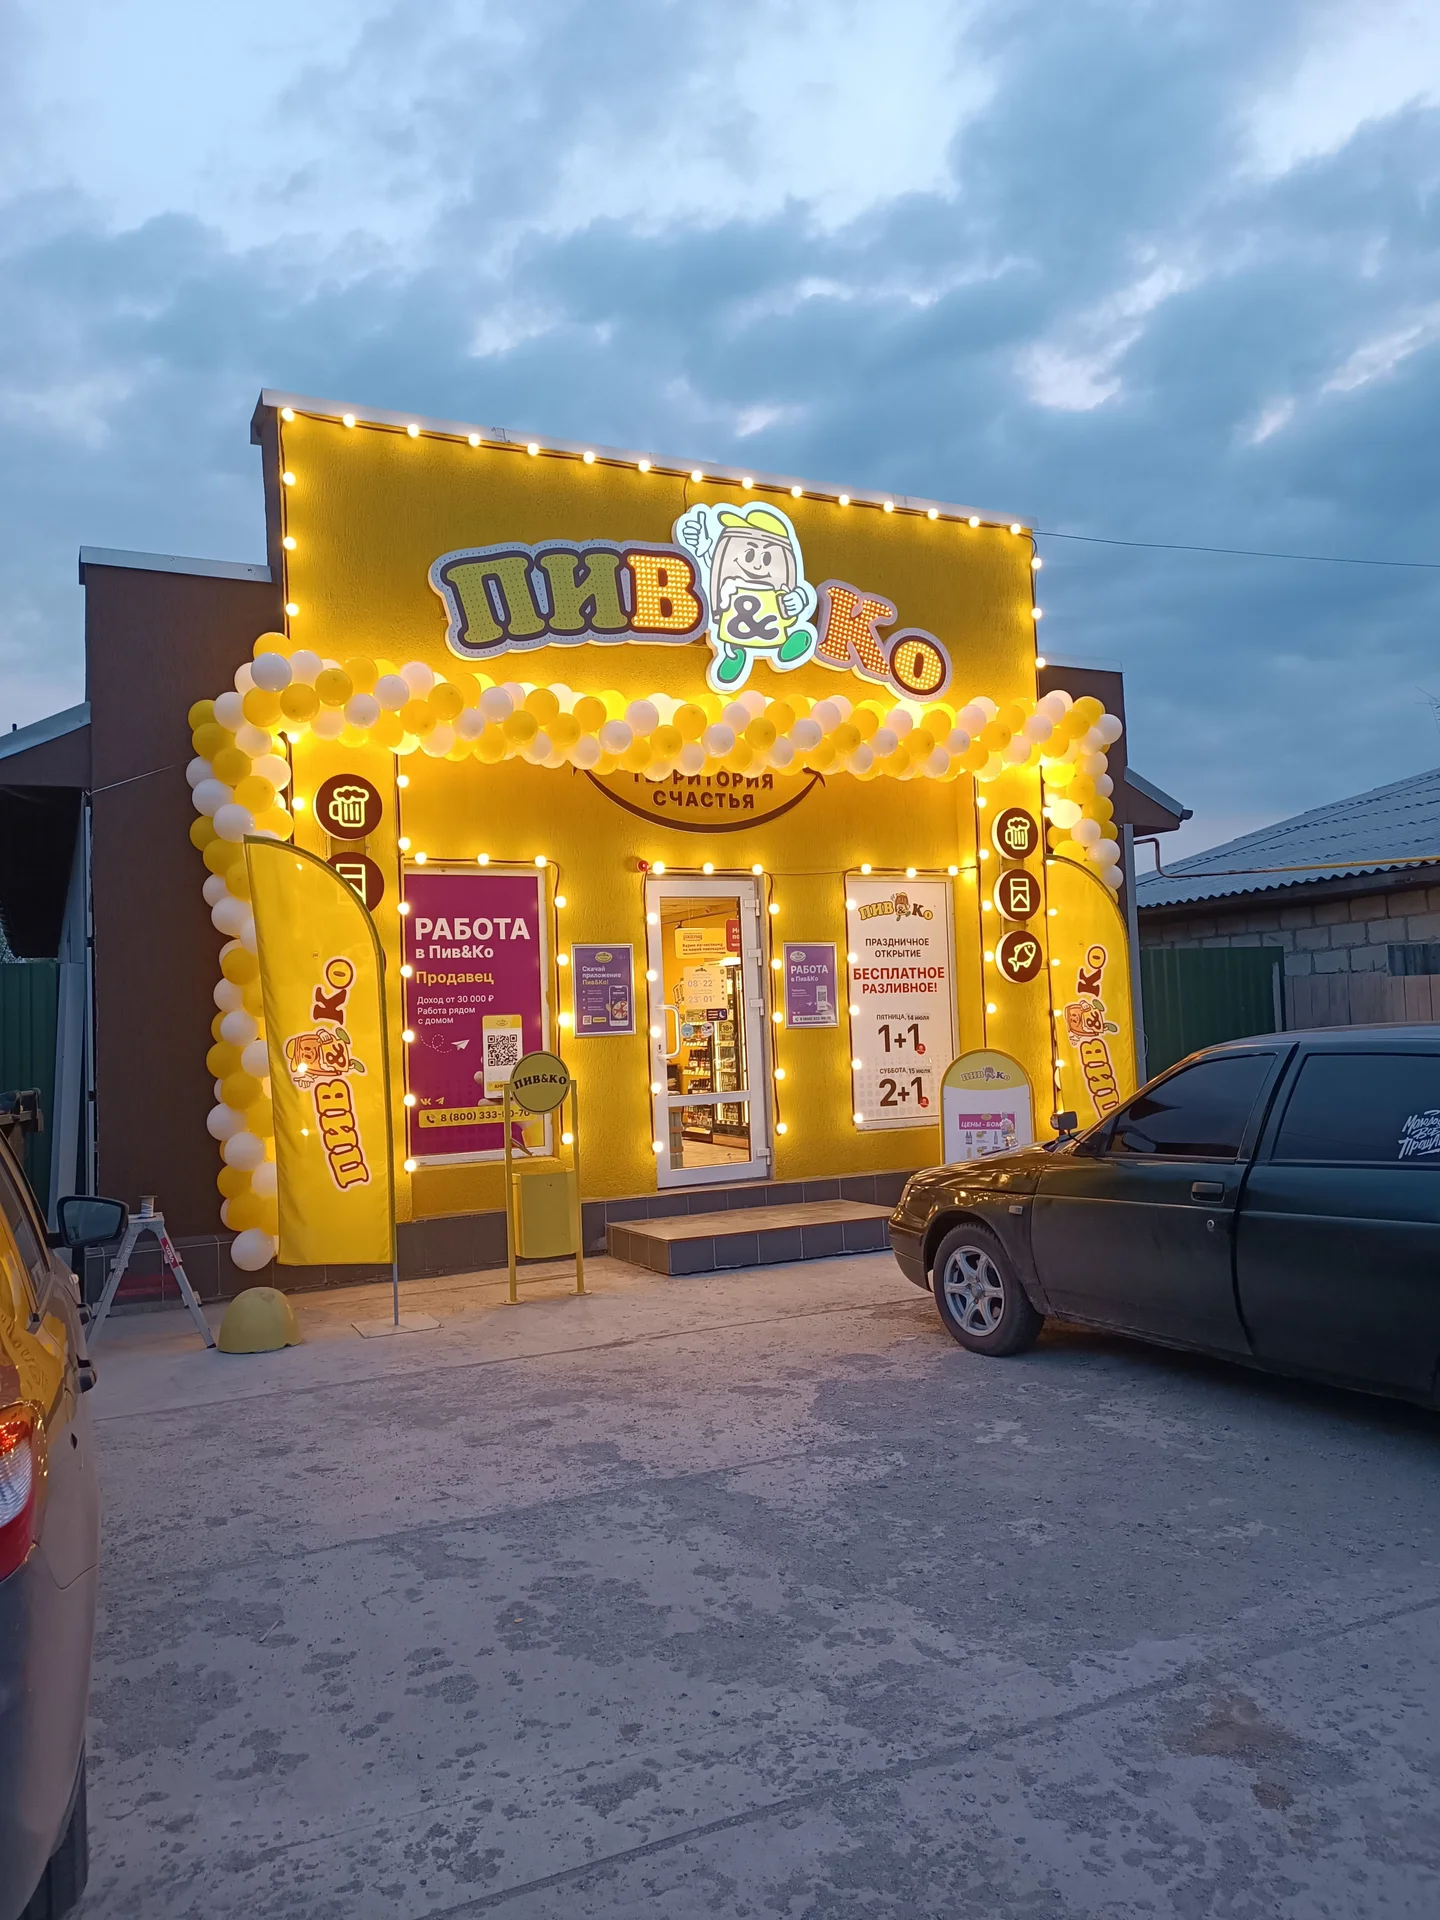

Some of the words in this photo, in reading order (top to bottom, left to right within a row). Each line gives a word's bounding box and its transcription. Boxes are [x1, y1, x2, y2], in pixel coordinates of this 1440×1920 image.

[443, 549, 703, 649] ПИВ
[727, 595, 780, 643] &
[634, 769, 774, 789] РИОРИЯ
[652, 790, 755, 809] СЧАСТЬЯ
[858, 901, 894, 921] ПИВ
[415, 918, 531, 940] РАБОТА
[865, 938, 930, 948] ПРАЗДНИЧНОЕ
[416, 949, 425, 958] в
[429, 945, 494, 958] Пив&Ко
[875, 949, 922, 958] ОТКРЫТИЕ
[790, 965, 829, 975] РАБОТА
[853, 967, 945, 980] БЕСПЛАТНОЕ
[416, 971, 495, 987] Продавец
[862, 982, 938, 994] РАЗЛИВНОЕ!
[417, 996, 444, 1005] Доход
[457, 995, 468, 1003] 30
[470, 995, 486, 1003] 000
[417, 1007, 447, 1015] Работа
[425, 1017, 454, 1025] домом
[878, 1023, 920, 1053] 1+1
[961, 1070, 985, 1081] ПИВ
[878, 1076, 923, 1107] 2+1
[440, 1114, 447, 1122] 8
[449, 1111, 477, 1122] (800)
[479, 1108, 531, 1120] 333-0-70
[314, 1079, 370, 1190] ПИВ
